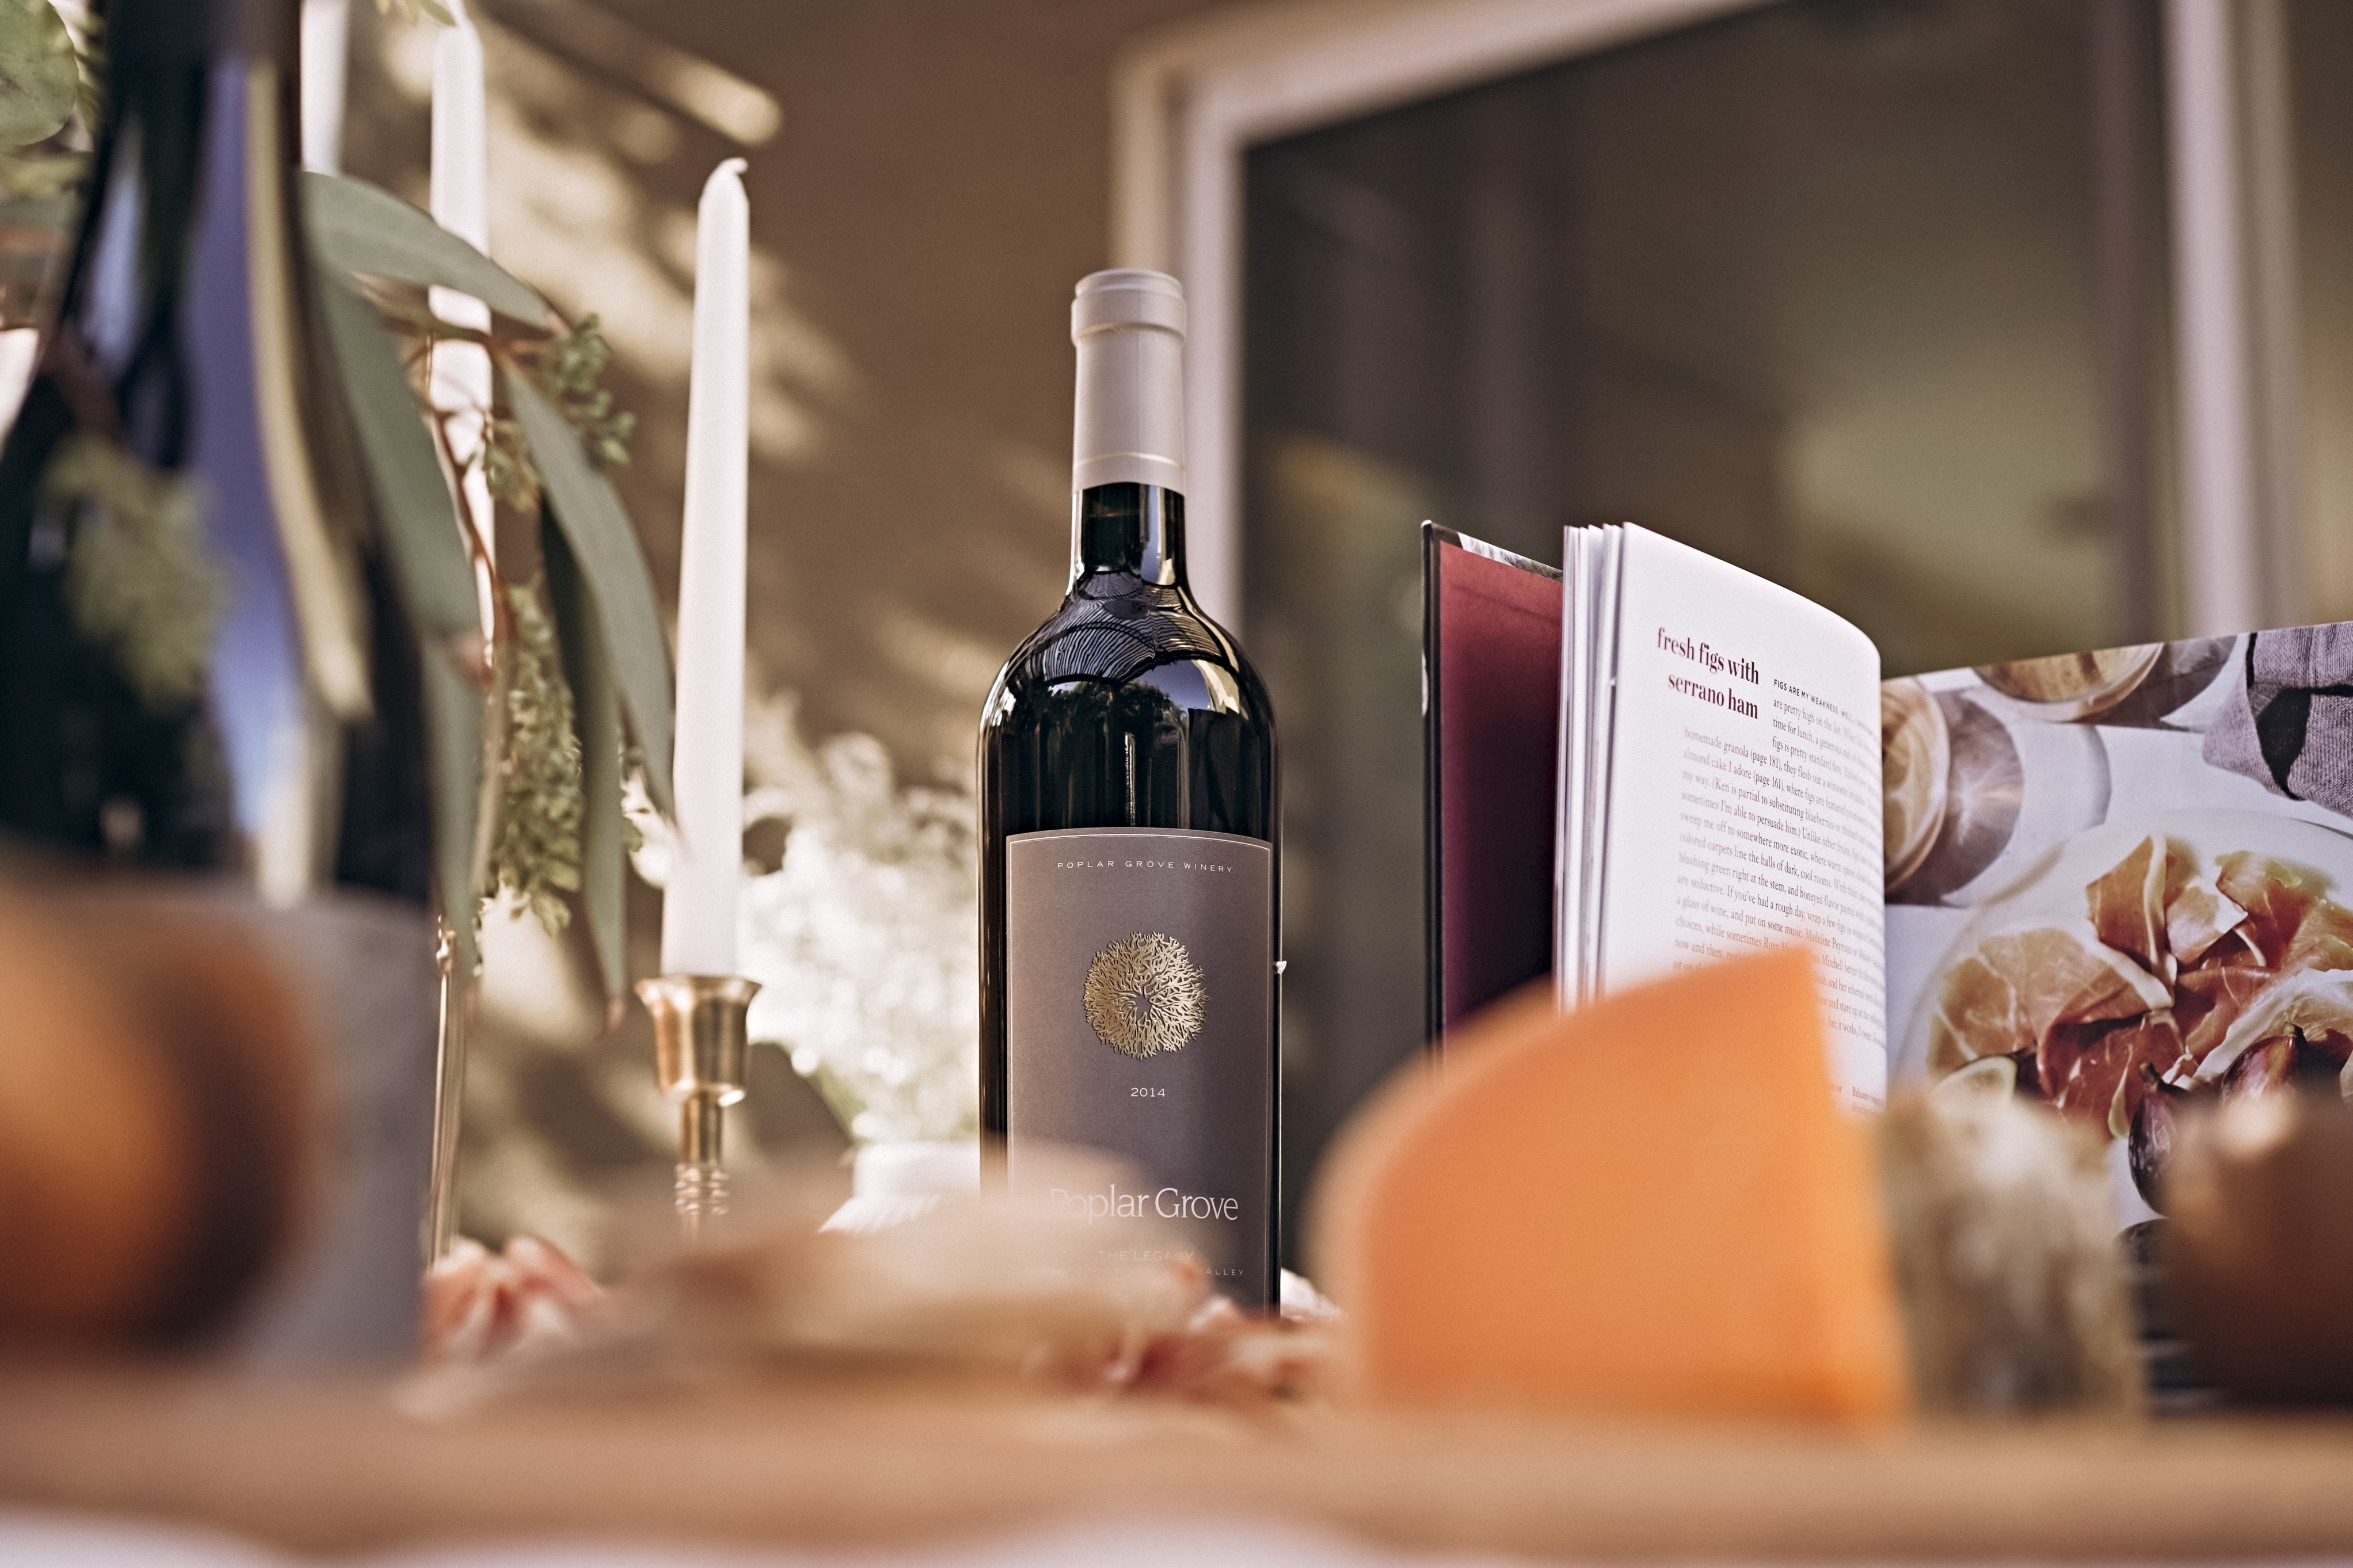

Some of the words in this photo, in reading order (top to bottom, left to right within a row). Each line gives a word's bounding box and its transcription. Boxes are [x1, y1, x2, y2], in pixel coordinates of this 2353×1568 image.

[1657, 627, 1694, 661] fresh
[1699, 642, 1724, 674] figs
[1728, 658, 1759, 685] with
[1669, 673, 1724, 707] serrano
[1728, 688, 1758, 719] ham
[1773, 699, 1783, 709] are
[1784, 703, 1801, 720] pretty
[1803, 707, 1814, 725] high
[1816, 717, 1822, 726] on
[1824, 719, 1832, 730] the
[1775, 679, 1787, 690] FIGS
[1789, 686, 1799, 696] ARE
[1802, 691, 1809, 700] MY
[1685, 726, 1722, 748] homemade
[1724, 743, 1748, 757] granola
[1750, 749, 1767, 766] (page
[1769, 756, 1783, 772] 181),
[1784, 761, 1796, 778] they
[1798, 766, 1811, 780] flesh
[1813, 775, 1821, 785] out
[1773, 717, 1786, 731] time
[1788, 722, 1796, 735] for
[1798, 726, 1814, 743] lunch,
[1773, 735, 1783, 752] figs
[1785, 741, 1789, 752] is
[1791, 746, 1807, 762] pretty
[1809, 754, 1832, 770] standard
[1684, 747, 1709, 765] almond
[1711, 758, 1727, 770] cake
[1729, 761, 1731, 772] I
[1734, 765, 1751, 779] adore
[1753, 770, 1770, 787] (page
[1772, 777, 1785, 792] 161),
[1787, 783, 1803, 798] where
[1805, 788, 1815, 804] figs
[1682, 792, 1719, 809] sometimes
[1721, 800, 1731, 814] I'm
[1734, 805, 1747, 819] able
[1749, 811, 1756, 821] to
[1757, 815, 1784, 831] persuade
[1785, 821, 1801, 838] him.)
[1803, 827, 1821, 844] Unlike
[1822, 835, 1836, 852] other
[1696, 775, 1710, 789] way.
[1712, 777, 1729, 792] (Ken
[1732, 783, 1737, 794] is
[1739, 788, 1760, 802] partial
[1761, 795, 1768, 805] to
[1769, 797, 1804, 821] substituting
[1806, 808, 1834, 829] blueberries
[1058, 860, 1114, 869] POPLAR
[1125, 860, 1174, 868] GROVE
[1183, 862, 1233, 873] WINERY
[1680, 833, 1706, 848] colored
[1708, 842, 1733, 856] carpets
[1735, 845, 1747, 860] line
[1749, 850, 1759, 864] the
[1761, 853, 1775, 869] halls
[1777, 860, 1784, 871] of
[1785, 861, 1799, 877] dark,
[1801, 870, 1813, 881] cool
[1814, 875, 1832, 888] rooms.
[1704, 819, 1714, 829] me
[1716, 821, 1727, 833] off
[1728, 826, 1735, 835] to
[1737, 829, 1772, 847] somewhere
[1774, 840, 1789, 852] more
[1791, 847, 1809, 860] exotic,
[1811, 852, 1826, 866] where
[1827, 860, 1842, 872] warm
[1678, 850, 1709, 873] blushing
[1711, 863, 1730, 875] green
[1733, 867, 1749, 883] right
[1750, 874, 1756, 884] at
[1758, 874, 1768, 886] the
[1770, 879, 1785, 892] stem,
[1788, 885, 1798, 896] and
[1800, 886, 1823, 905] honeyed
[1825, 895, 1839, 910] flavor
[1691, 875, 1724, 895] seductive.
[1727, 885, 1734, 897] If
[1735, 890, 1756, 904] you've
[1757, 894, 1769, 907] had
[1771, 901, 1773, 909] a
[1775, 902, 1792, 917] rough
[1795, 905, 1806, 920] day,
[1807, 912, 1821, 926] wrap
[1827, 915, 1835, 928] few
[1837, 919, 1846, 935] figs
[1676, 914, 1704, 933] choices,
[1706, 922, 1724, 937] while
[1727, 932, 1762, 948] sometimes
[1764, 937, 1779, 951] Roxy
[1822, 953, 1843, 971] Mitchell
[1701, 899, 1709, 912] of
[1711, 903, 1729, 918] wine,
[1731, 910, 1743, 922] and
[1745, 914, 1756, 926] put
[1758, 918, 1765, 928] on
[1768, 921, 1783, 933] some
[1785, 926, 1803, 938] music.
[1805, 928, 1831, 948] Madeline
[1674, 956, 1683, 970] sit
[1684, 962, 1693, 972] on
[1829, 998, 1838, 1010] and
[1840, 1002, 1851, 1013] stare
[1675, 938, 1689, 949] now
[1692, 940, 1705, 954] and
[1707, 943, 1724, 959] then,
[1828, 974, 1837, 989] and
[1828, 1016, 1837, 1029] but
[1838, 1018, 1842, 1030] it
[1843, 1023, 1858, 1036] works,
[1130, 1088, 1166, 1097] 2014
[1050, 1184, 1149, 1224] Poplar
[1155, 1188, 1238, 1220] Grove
[1098, 1251, 1128, 1260] THE
